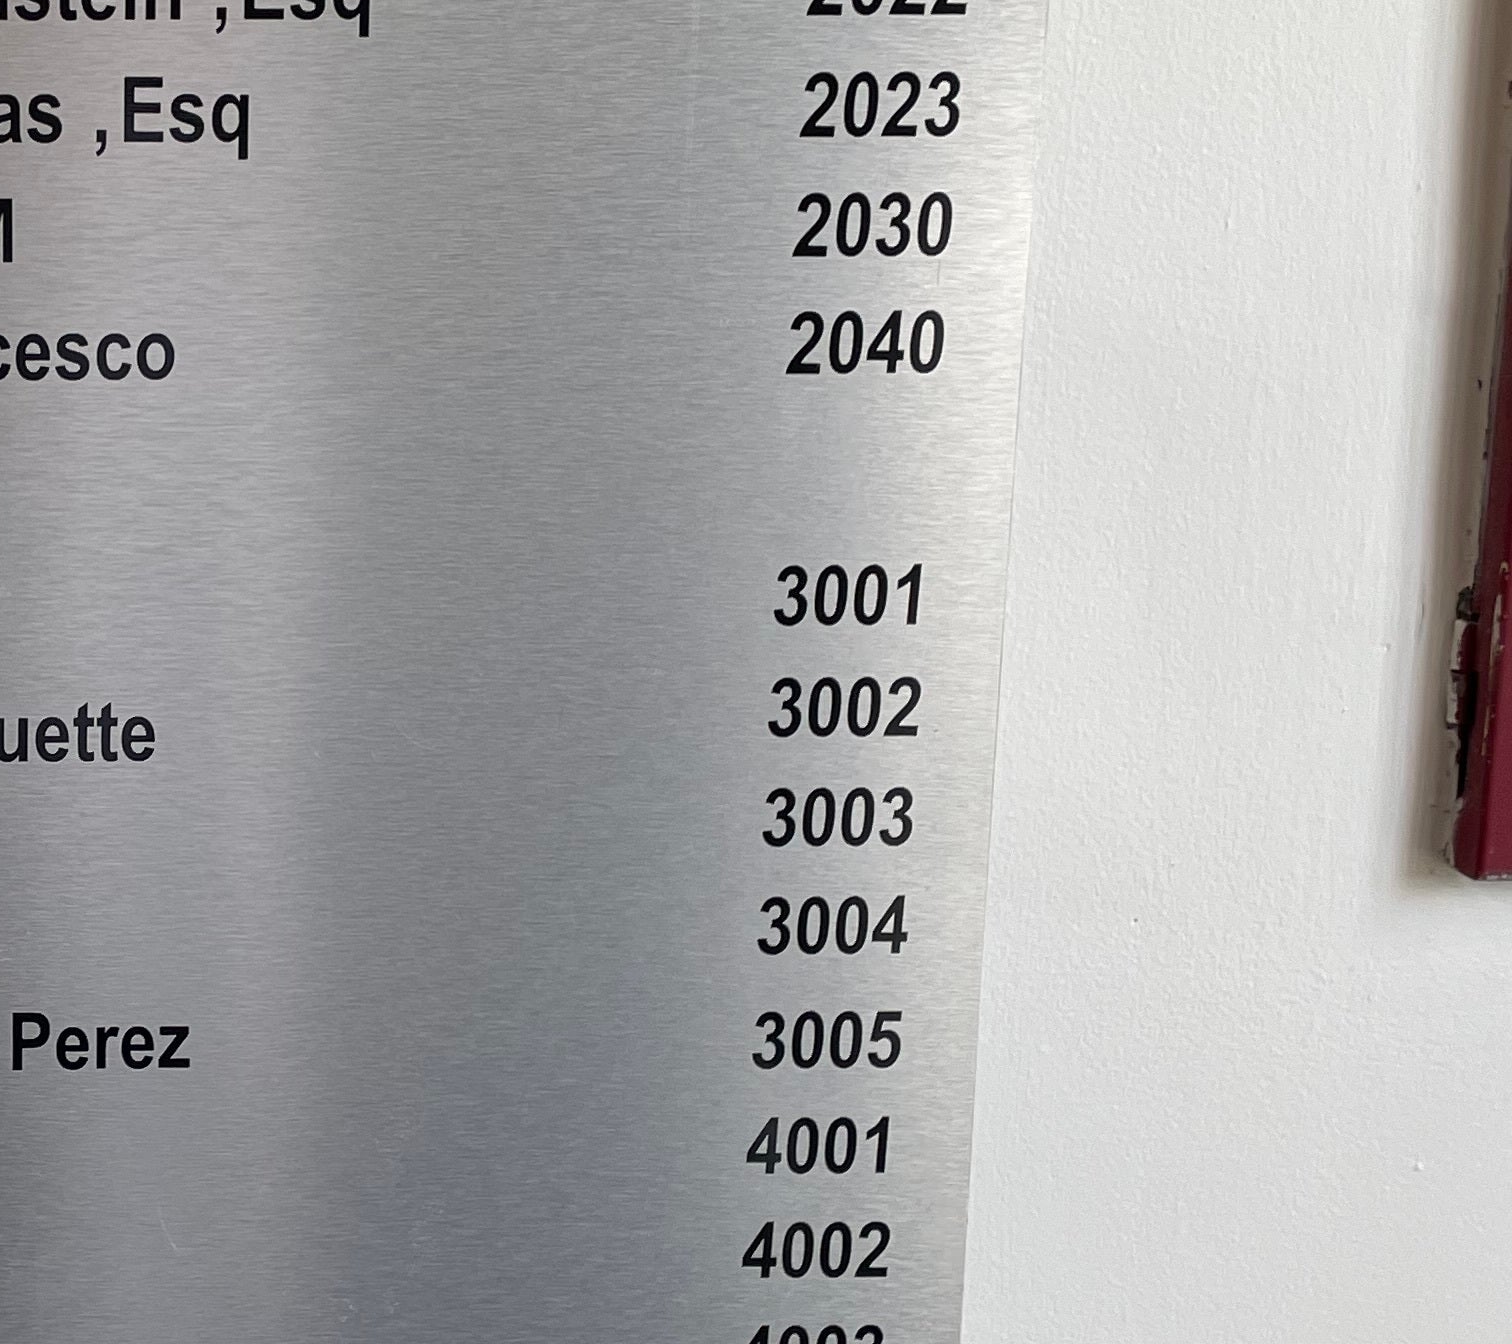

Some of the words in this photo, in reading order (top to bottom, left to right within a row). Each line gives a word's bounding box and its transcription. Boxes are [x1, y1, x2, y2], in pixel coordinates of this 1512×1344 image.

[799, 70, 961, 138] 2023
[791, 191, 953, 258] 2030
[785, 309, 945, 375] 2040
[773, 563, 923, 627] 3001
[767, 676, 922, 738] 3002
[762, 786, 913, 848] 3003
[756, 894, 909, 956] 3004
[11, 1012, 191, 1071] Perez
[751, 1010, 903, 1070] 3005
[745, 1115, 890, 1175] 4001
[741, 1221, 891, 1279] 4002
